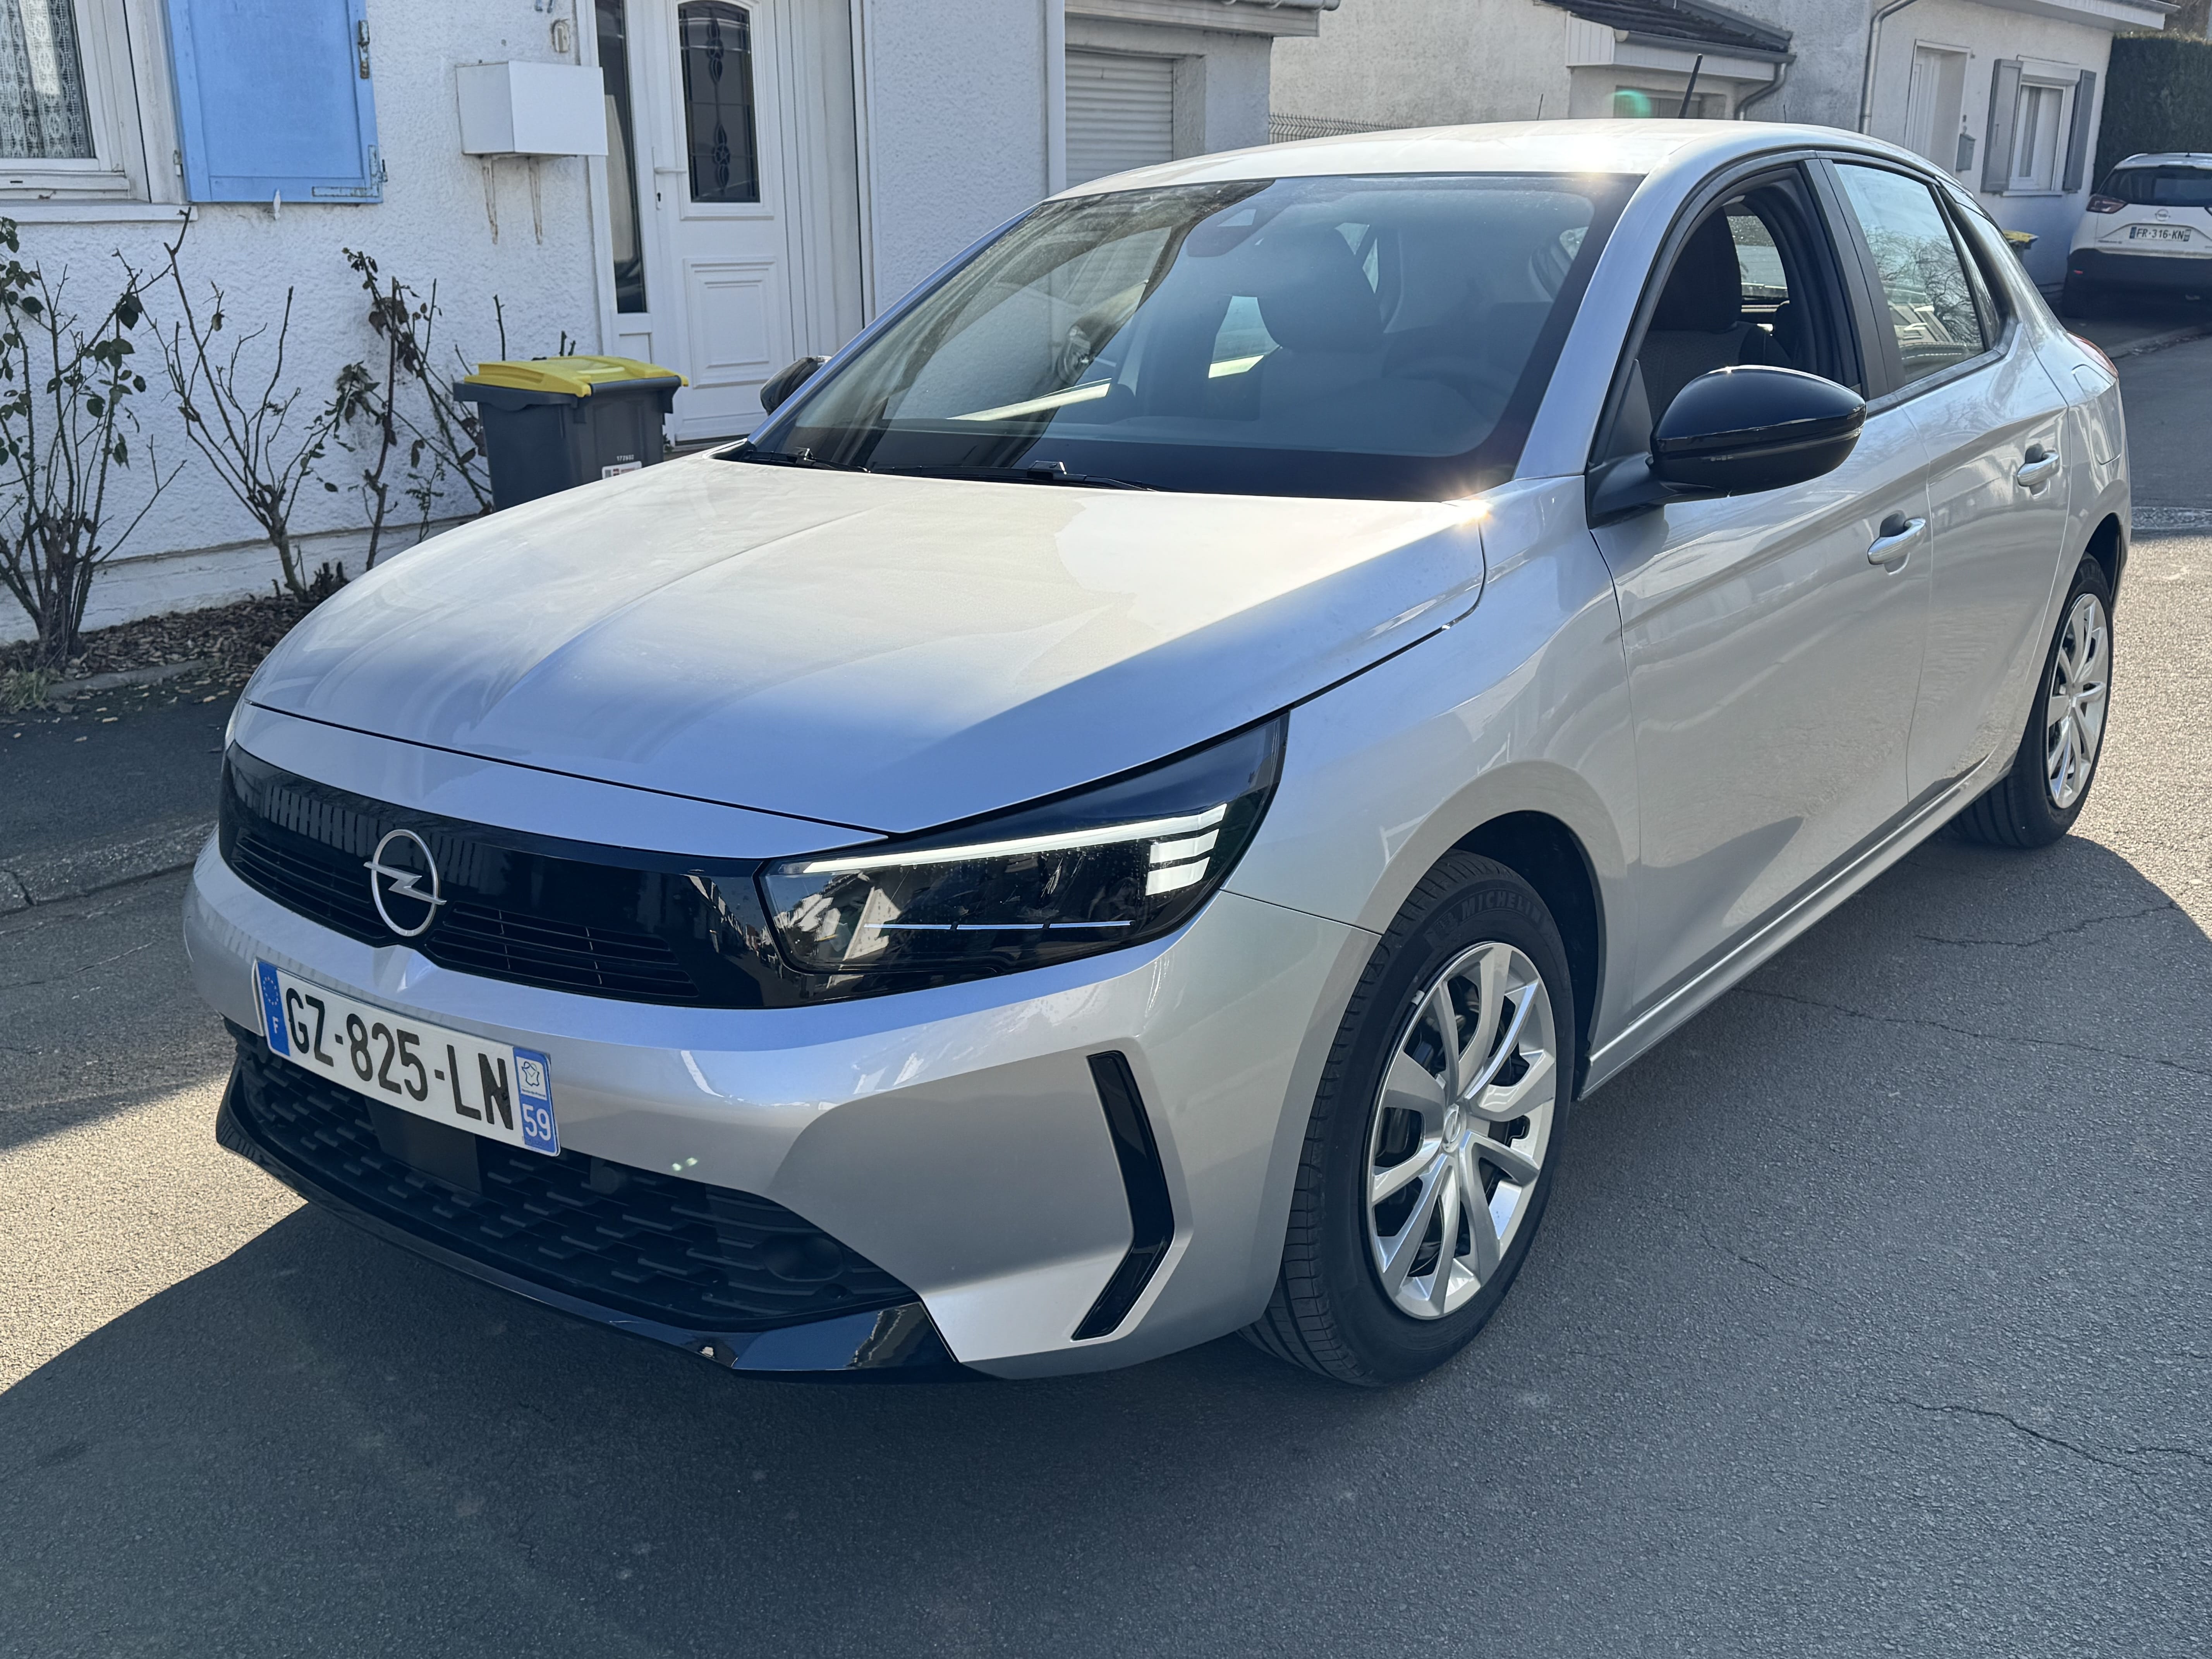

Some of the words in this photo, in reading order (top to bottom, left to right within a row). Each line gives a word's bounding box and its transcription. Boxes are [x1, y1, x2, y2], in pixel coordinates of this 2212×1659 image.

[2136, 228, 2184, 240] FR-316-KN
[1462, 891, 1541, 924] MICHELIN
[272, 1017, 279, 1034] F
[286, 988, 514, 1130] GZ-825-LN
[523, 1103, 551, 1141] 59
